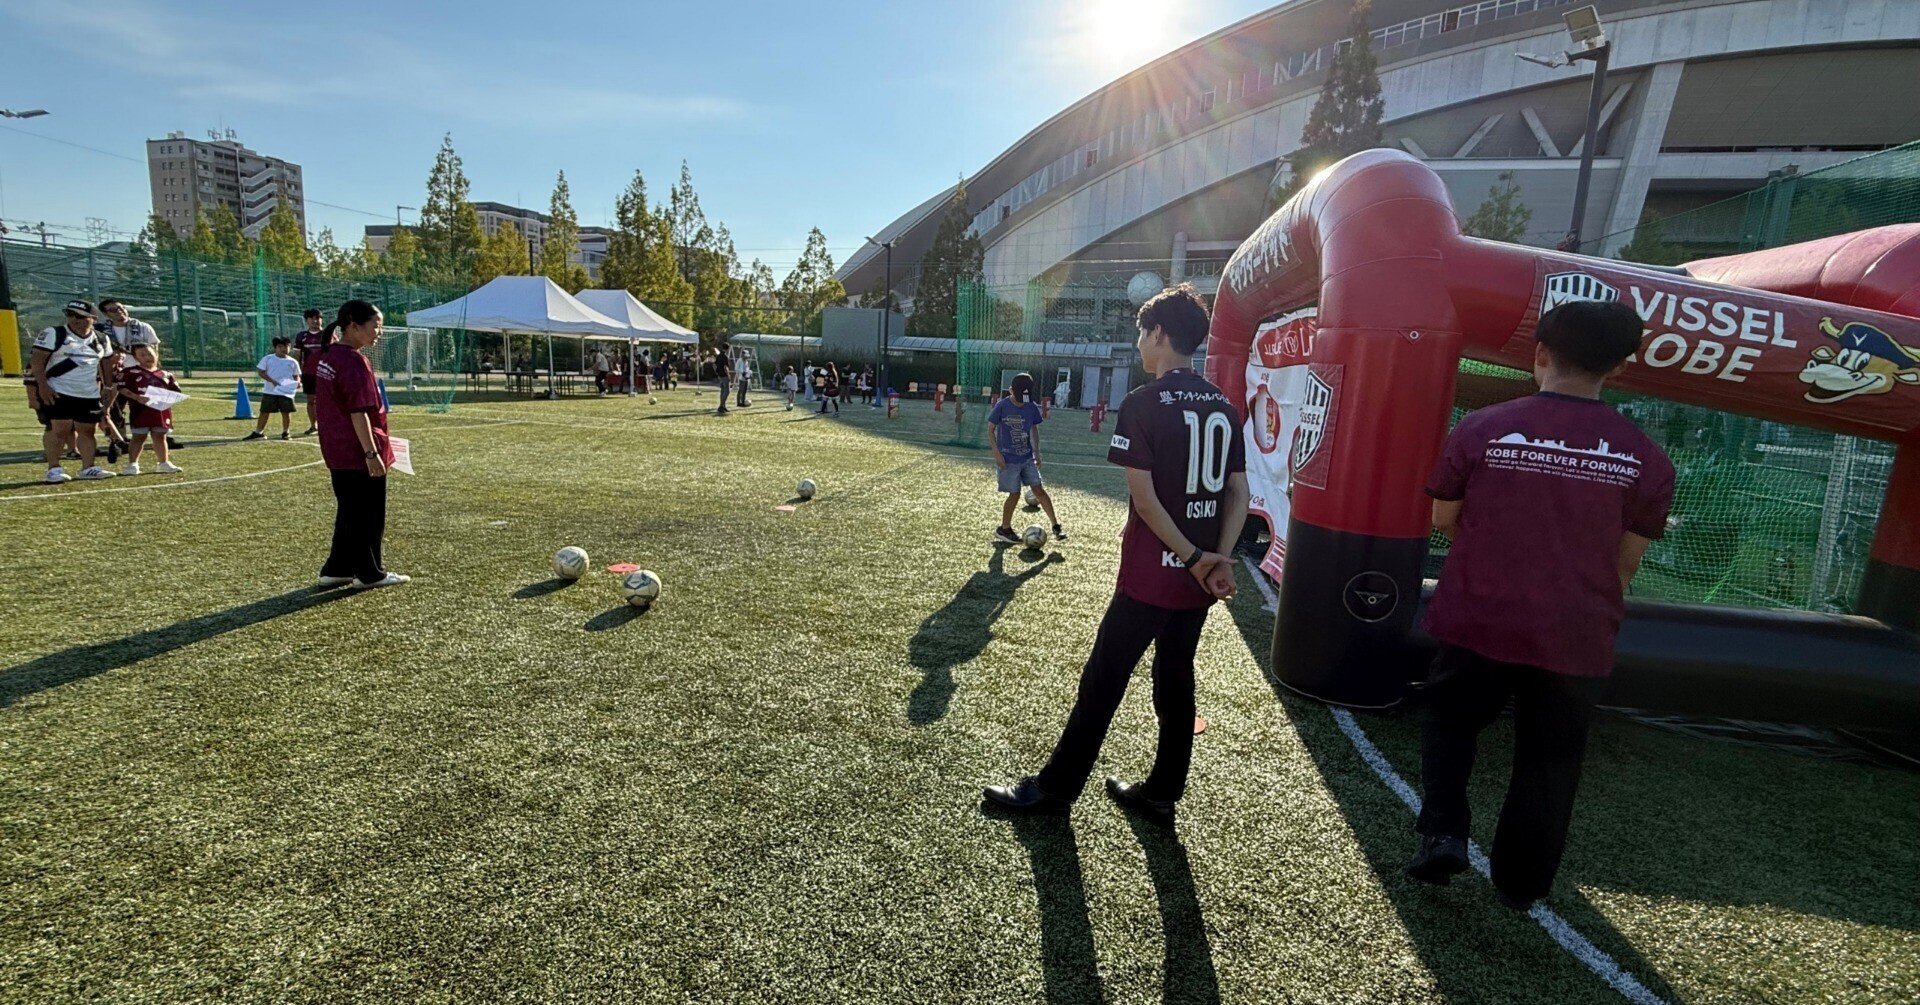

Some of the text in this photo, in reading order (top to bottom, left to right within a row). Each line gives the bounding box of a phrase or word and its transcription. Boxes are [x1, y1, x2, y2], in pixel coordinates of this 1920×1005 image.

[1629, 286, 1798, 349] VISSEL
[1183, 410, 1232, 494] 10
[1485, 448, 1640, 478] KOBE FOREVER FORWARD
[1519, 460, 1543, 468] forward
